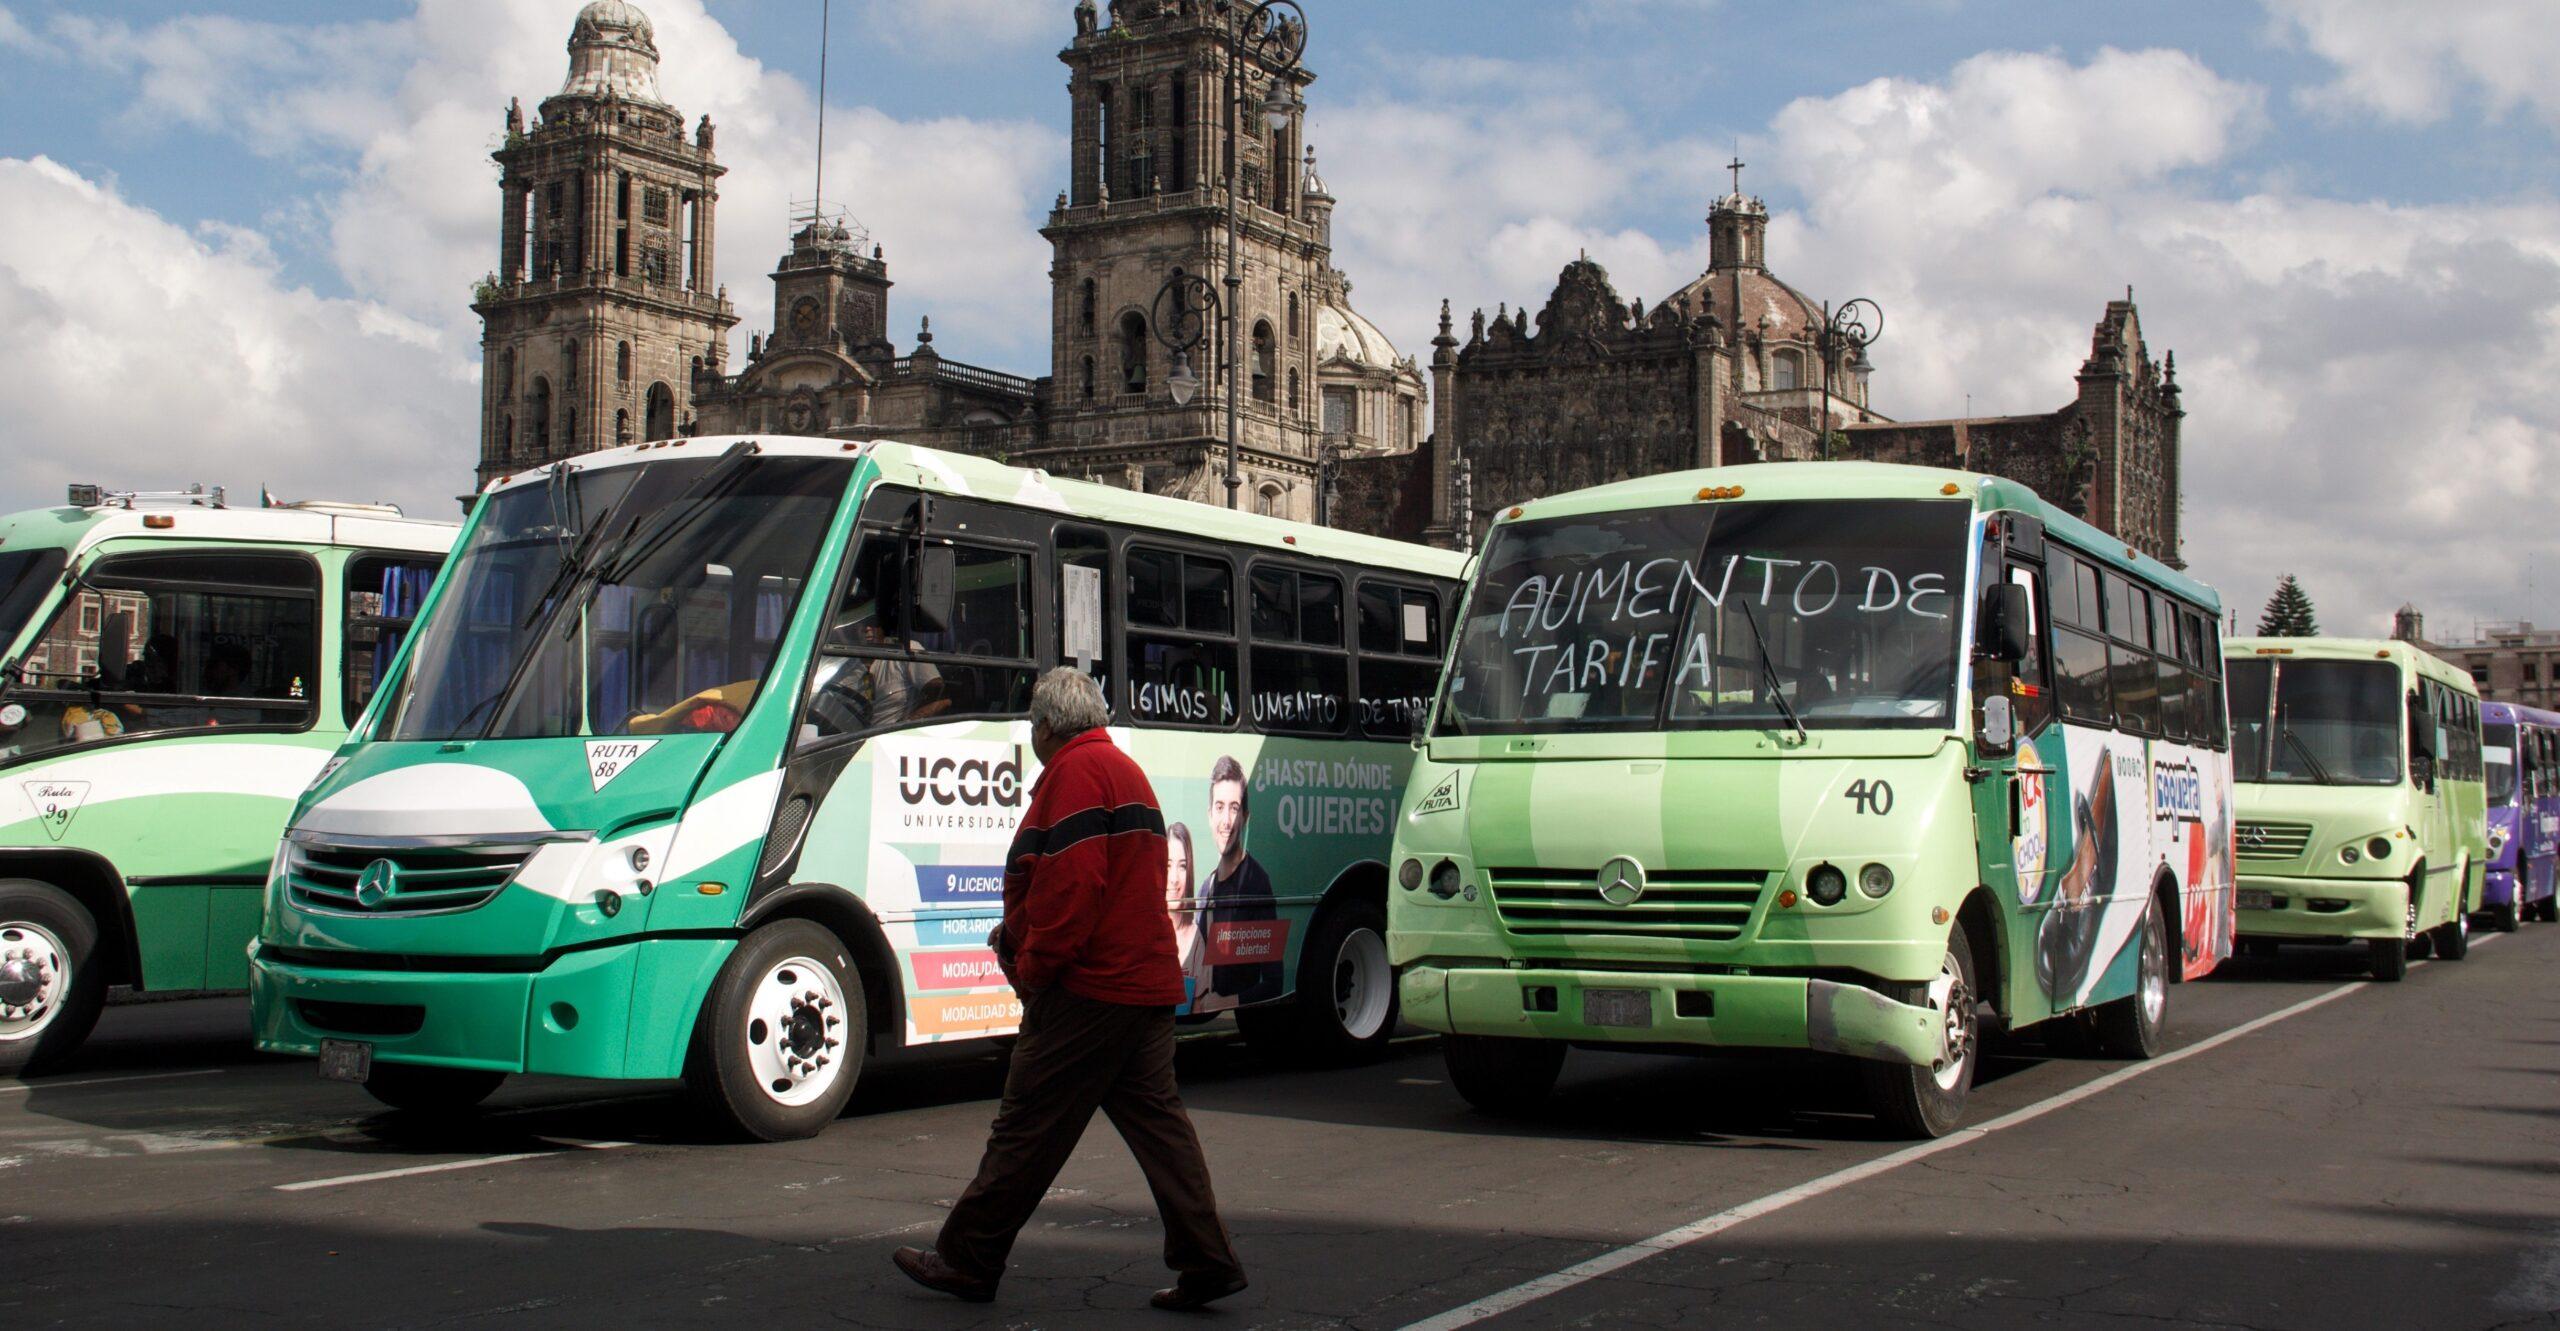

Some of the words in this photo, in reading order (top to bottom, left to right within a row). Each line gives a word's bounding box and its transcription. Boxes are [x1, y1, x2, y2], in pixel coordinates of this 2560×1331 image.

[1499, 554, 1840, 639] AUMENTO
[1859, 566, 1948, 620] DE
[1513, 632, 1712, 697] TARIFA
[1359, 697, 1386, 725] DE
[591, 744, 639, 758] RUTA
[594, 761, 618, 778] 88
[900, 744, 1022, 808] ucad
[1255, 758, 1329, 792] ¿HASTA
[1333, 756, 1393, 791] DÓNDE
[38, 785, 74, 798] Ruta
[1433, 784, 1452, 798] 88
[1844, 778, 1894, 816] 40
[1423, 797, 1452, 810] RUTA
[45, 802, 69, 826] 99
[904, 814, 1016, 829] UNIVERSIDAD
[1277, 794, 1385, 840] QUIERES
[946, 874, 957, 893] 9
[958, 876, 1004, 893] LICENCI
[1235, 942, 1271, 957] abiertas!
[942, 960, 1005, 979] MODALIDA
[942, 1003, 1007, 1023] MODALIDAD
